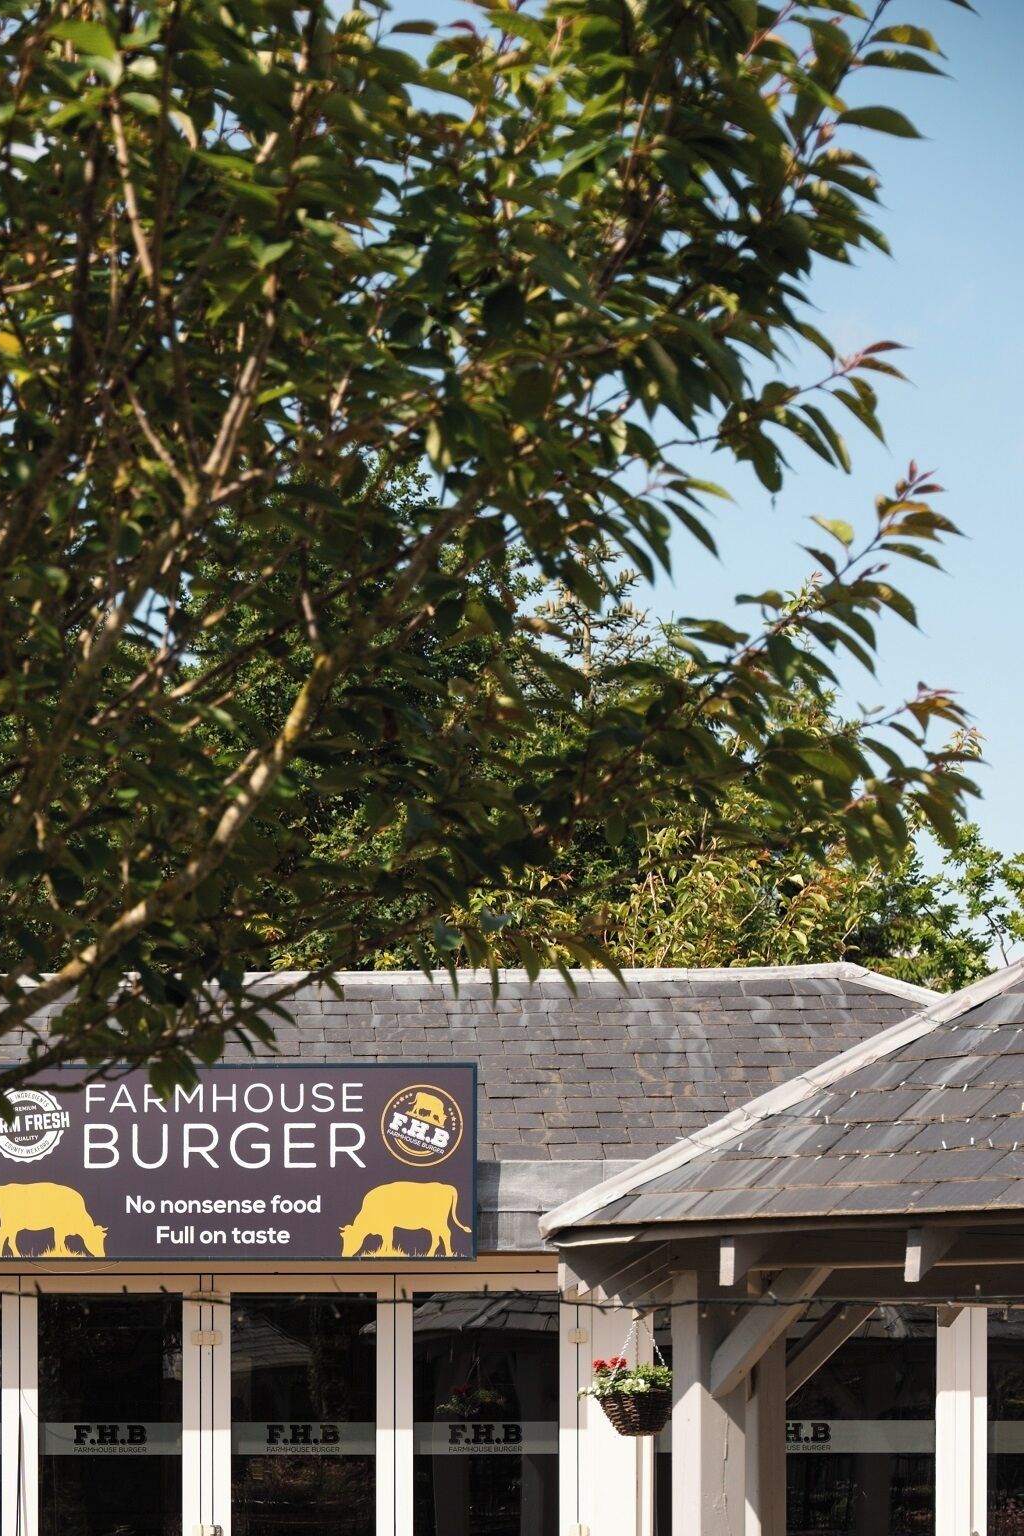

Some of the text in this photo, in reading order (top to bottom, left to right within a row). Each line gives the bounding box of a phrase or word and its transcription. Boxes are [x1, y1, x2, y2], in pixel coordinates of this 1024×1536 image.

[13, 1104, 37, 1112] REMIUM
[85, 1083, 364, 1113] FARMHOUSE
[24, 1111, 70, 1132] FRESH
[389, 1112, 450, 1148] F.H.B
[4, 1141, 24, 1154] COUNTY
[14, 1135, 39, 1143] QUALITY
[83, 1122, 367, 1169] BURGER
[386, 1129, 445, 1155] FARMHOUSE BURGER
[126, 1195, 321, 1214] No nonsense food
[156, 1226, 291, 1244] Full on taste
[73, 1424, 147, 1445] F.H.B
[266, 1424, 340, 1445] F.H.B
[448, 1424, 522, 1444] F.H.B
